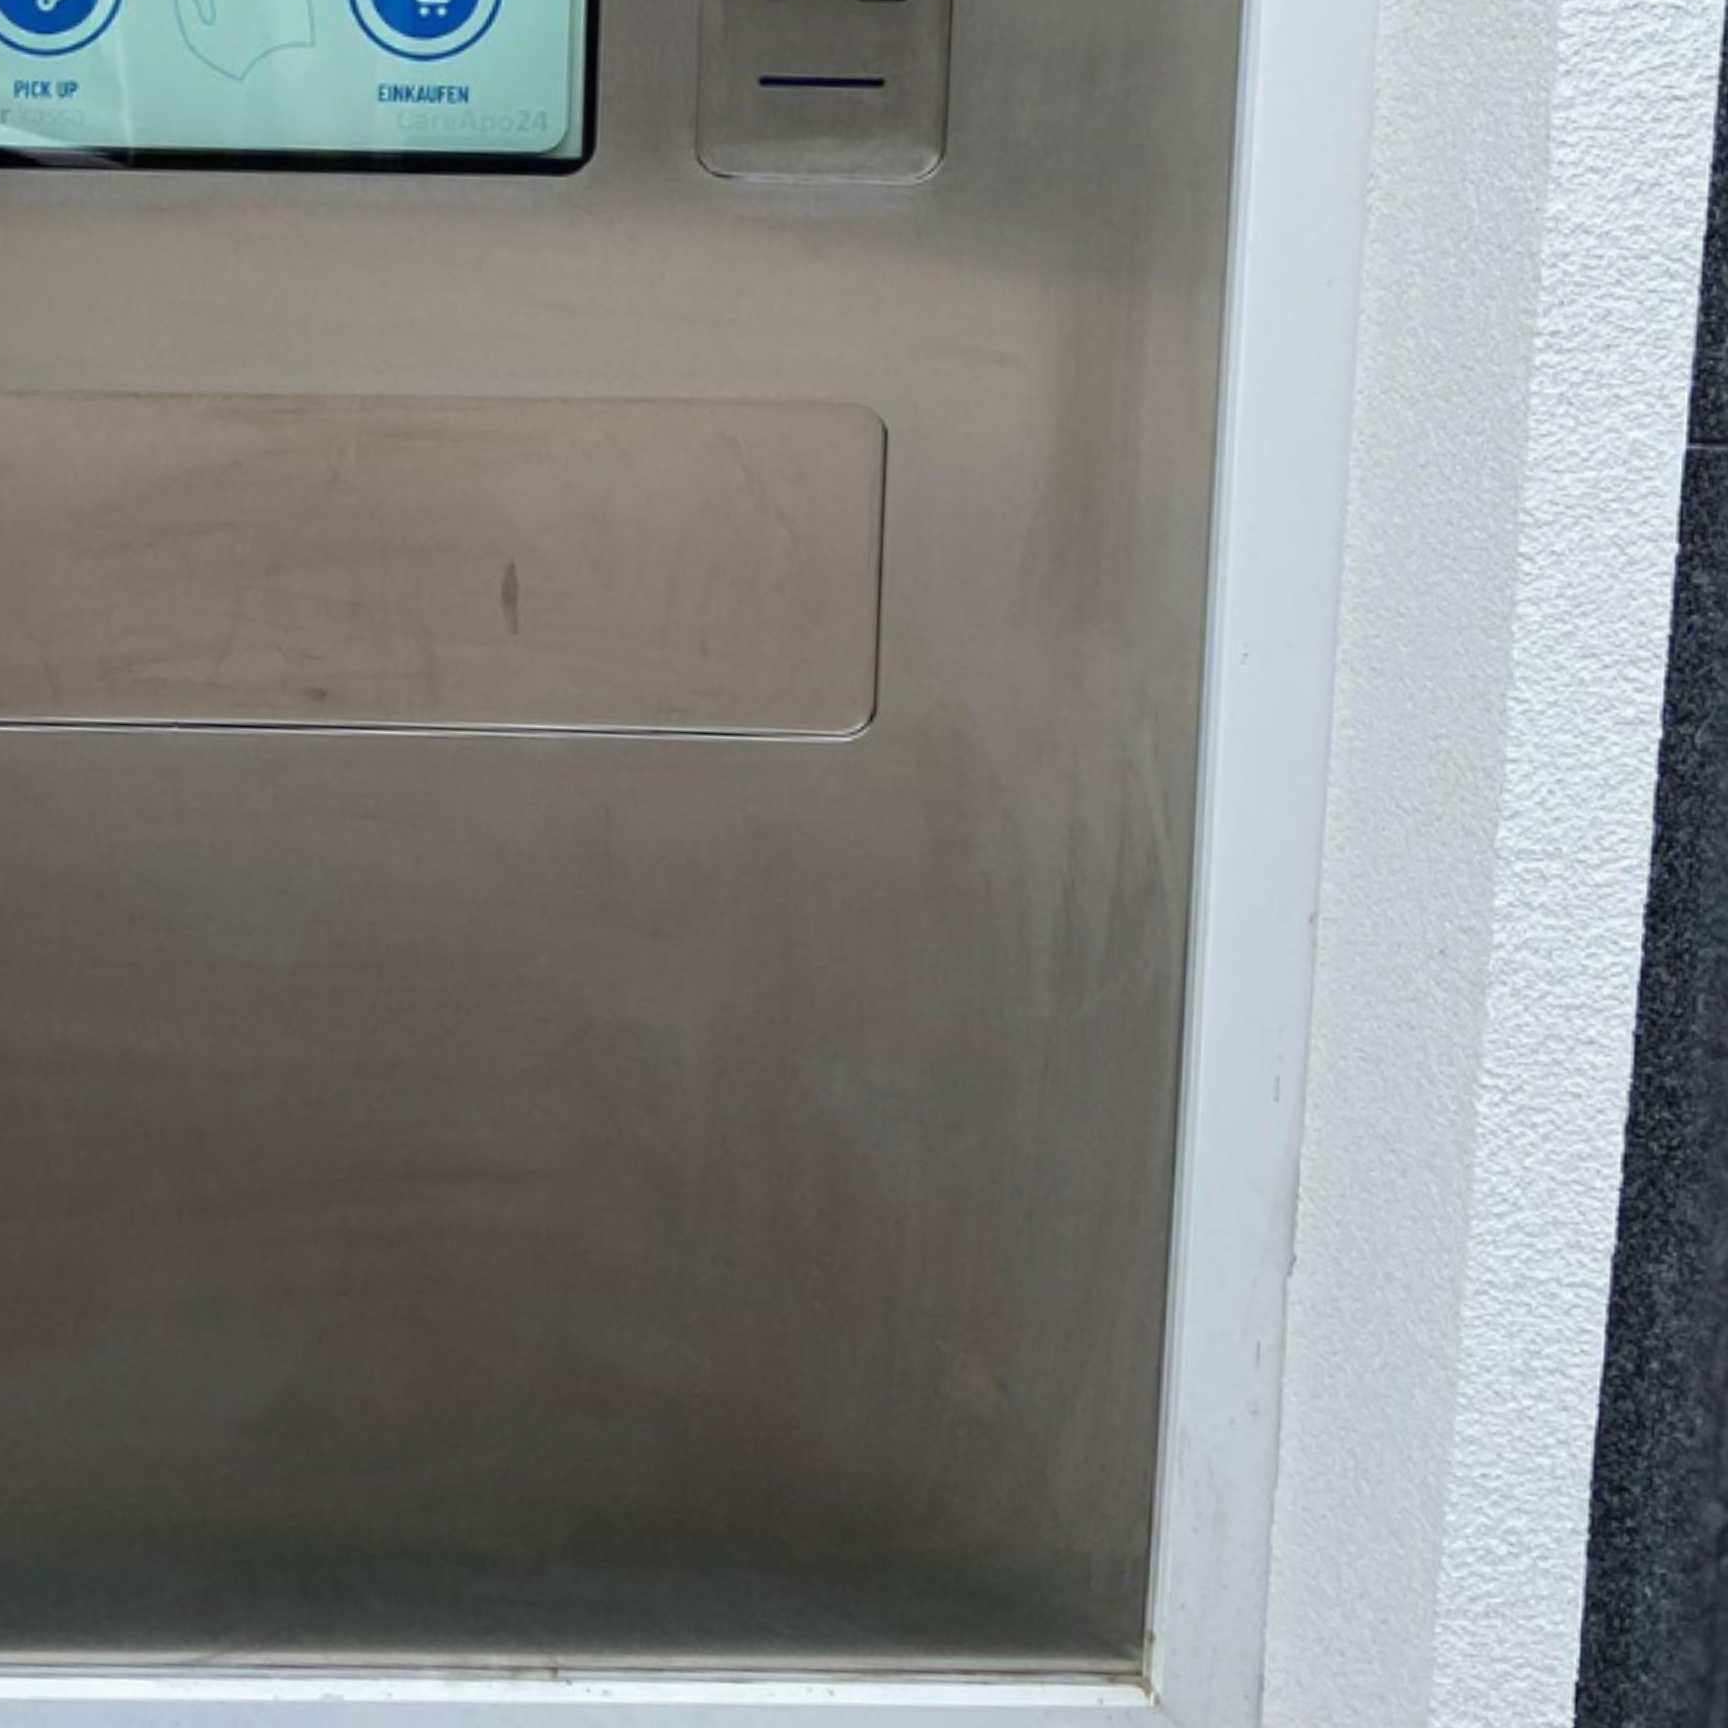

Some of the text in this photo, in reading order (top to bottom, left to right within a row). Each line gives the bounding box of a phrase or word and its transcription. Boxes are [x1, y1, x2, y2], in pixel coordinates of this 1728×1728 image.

[13, 79, 80, 99] PICK UP
[377, 83, 470, 104] EINKAUFEN
